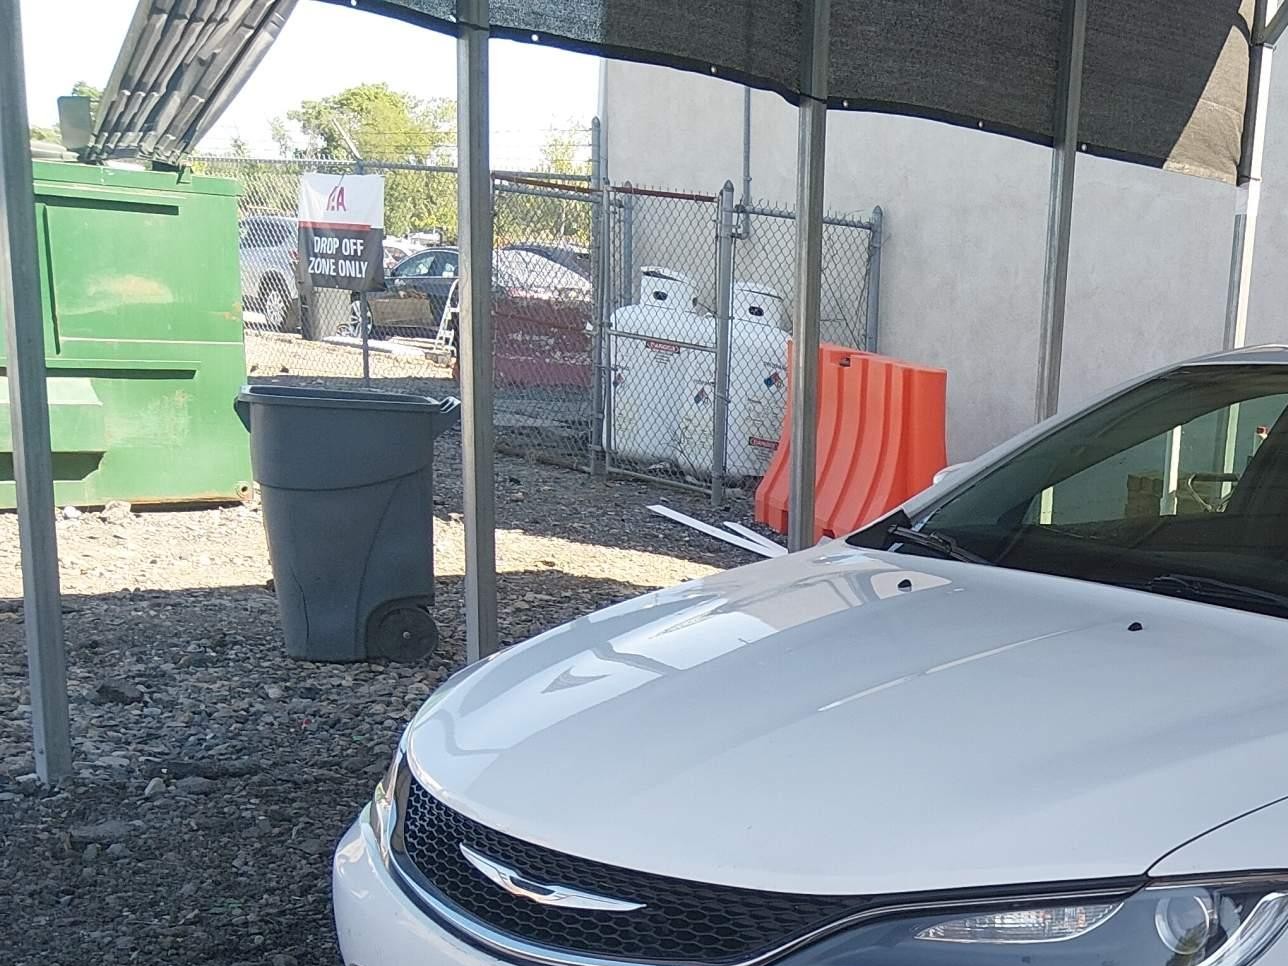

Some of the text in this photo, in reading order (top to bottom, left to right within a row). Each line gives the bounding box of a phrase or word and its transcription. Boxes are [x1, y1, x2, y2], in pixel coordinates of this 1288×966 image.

[314, 236, 364, 256] DROP OFF
[308, 257, 368, 278] ZONE ONLY
